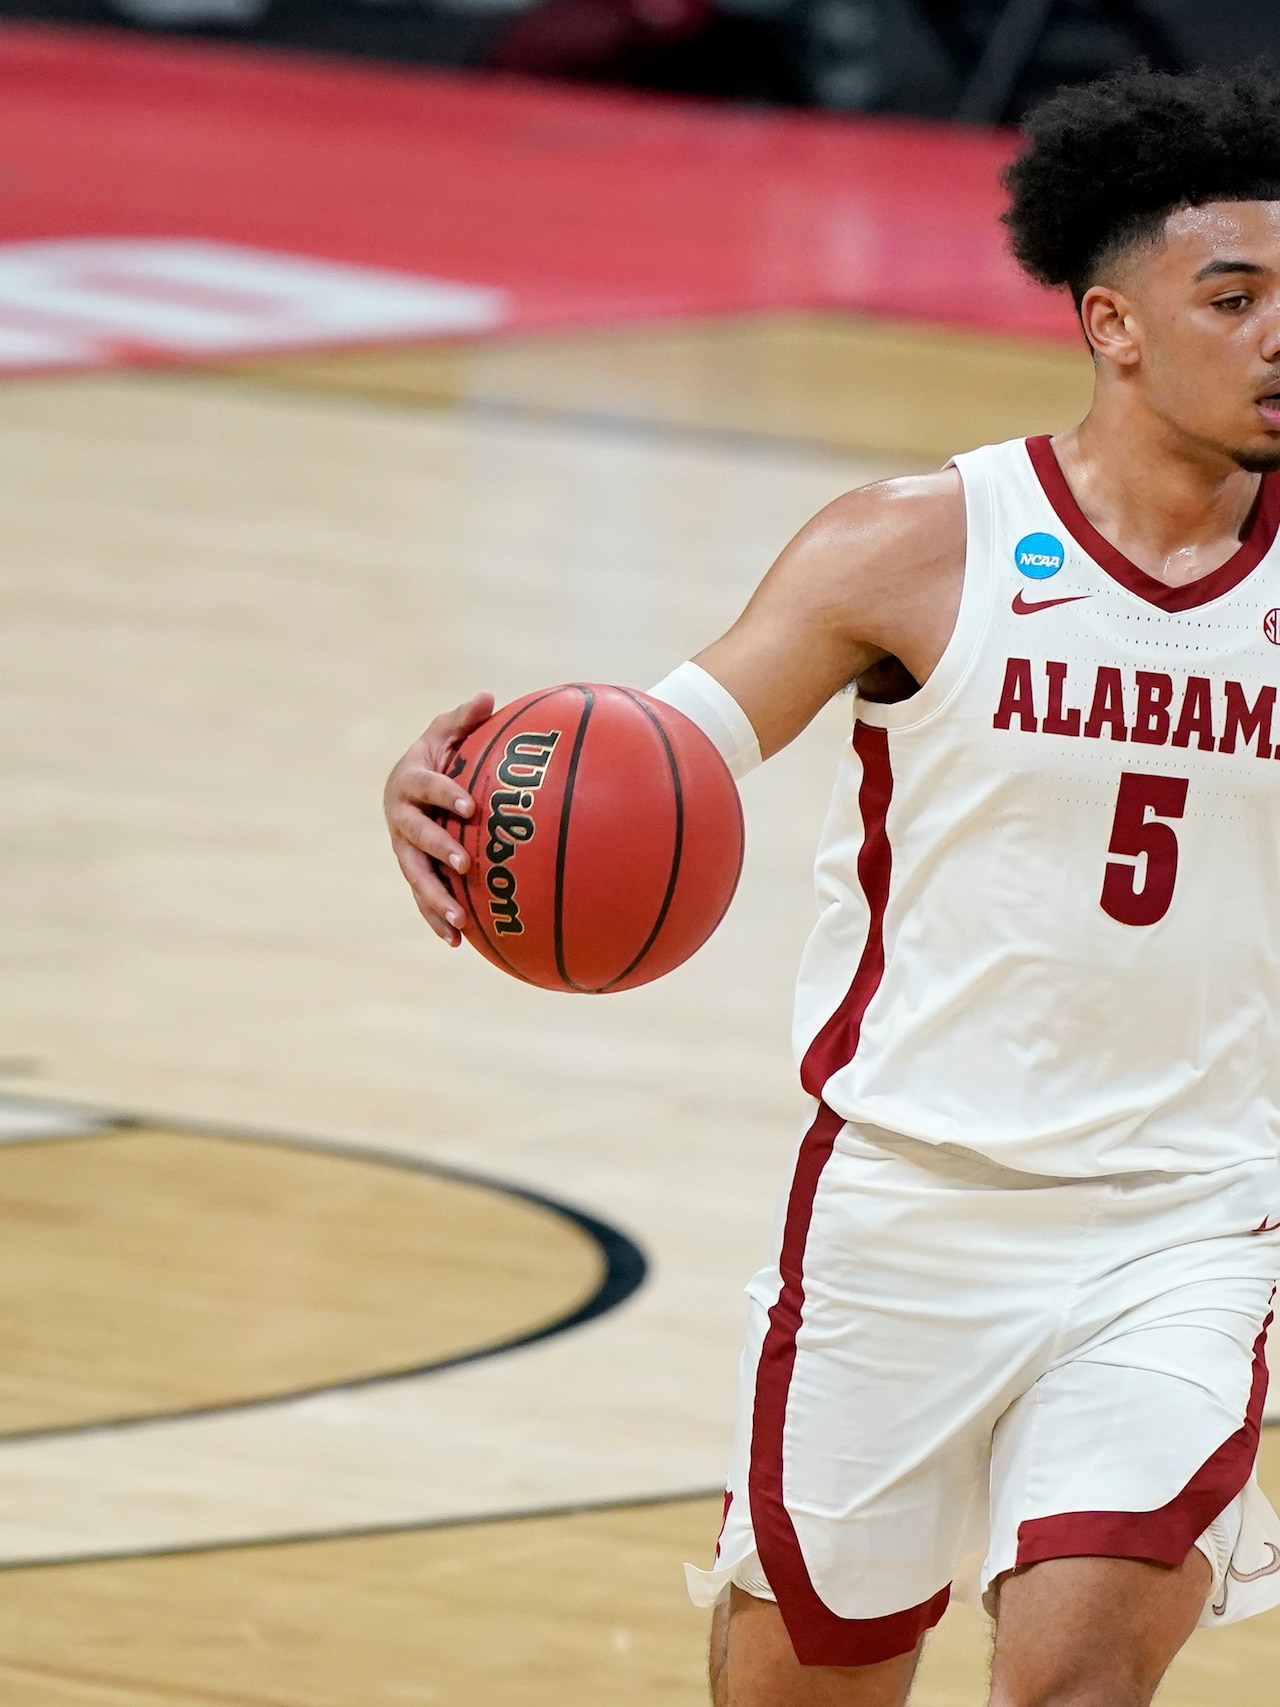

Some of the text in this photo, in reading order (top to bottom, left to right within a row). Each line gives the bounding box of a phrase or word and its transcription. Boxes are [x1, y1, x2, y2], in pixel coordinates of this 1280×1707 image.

[1019, 552, 1060, 568] NCAA
[485, 729, 562, 937] Wilson
[1100, 772, 1189, 927] 5
